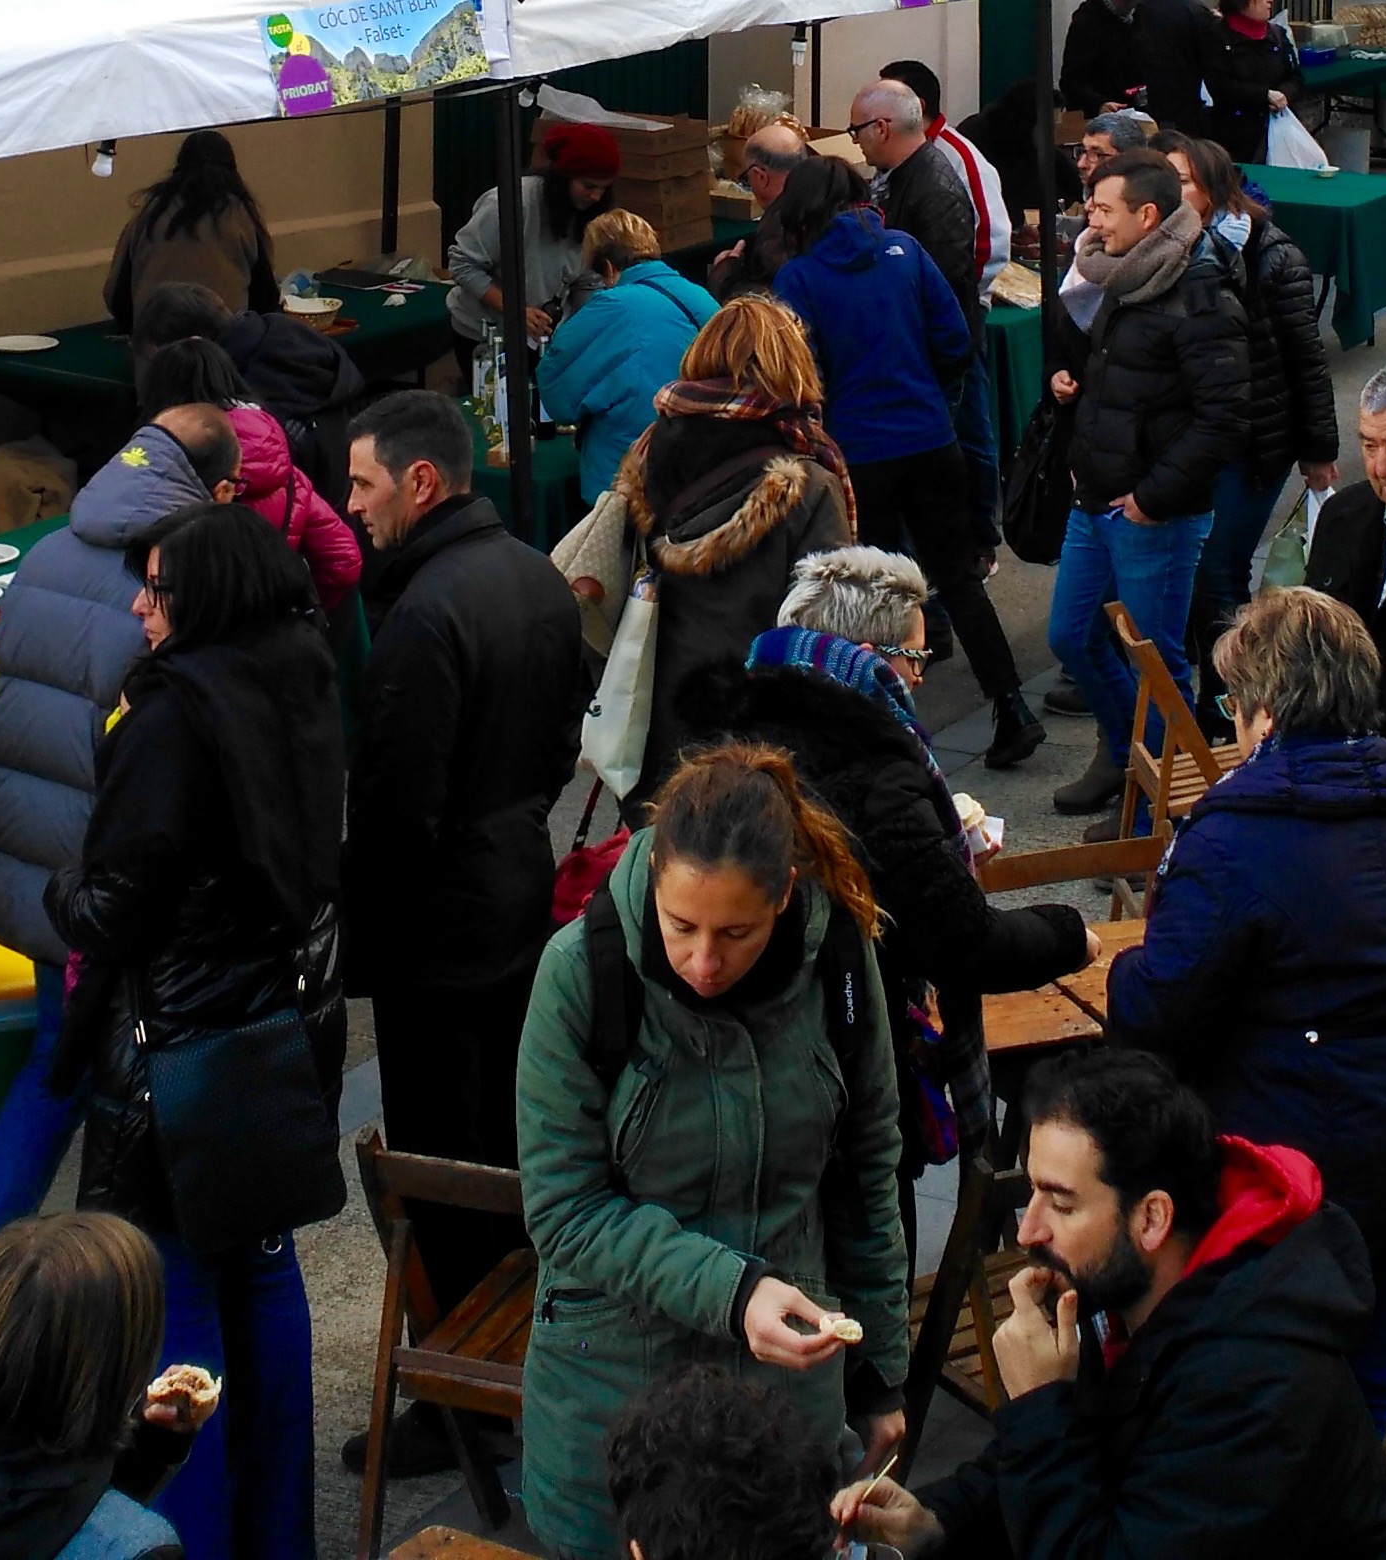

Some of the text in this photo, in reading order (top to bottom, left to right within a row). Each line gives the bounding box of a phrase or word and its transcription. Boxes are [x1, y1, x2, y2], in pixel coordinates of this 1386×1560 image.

[318, 6, 348, 30] CÓC
[349, 6, 368, 23] DE
[369, 0, 405, 20] SANT
[268, 23, 292, 35] TASTA
[364, 23, 406, 44] Falset
[282, 80, 329, 100] PRIORAT
[844, 972, 855, 1024] Quechua
